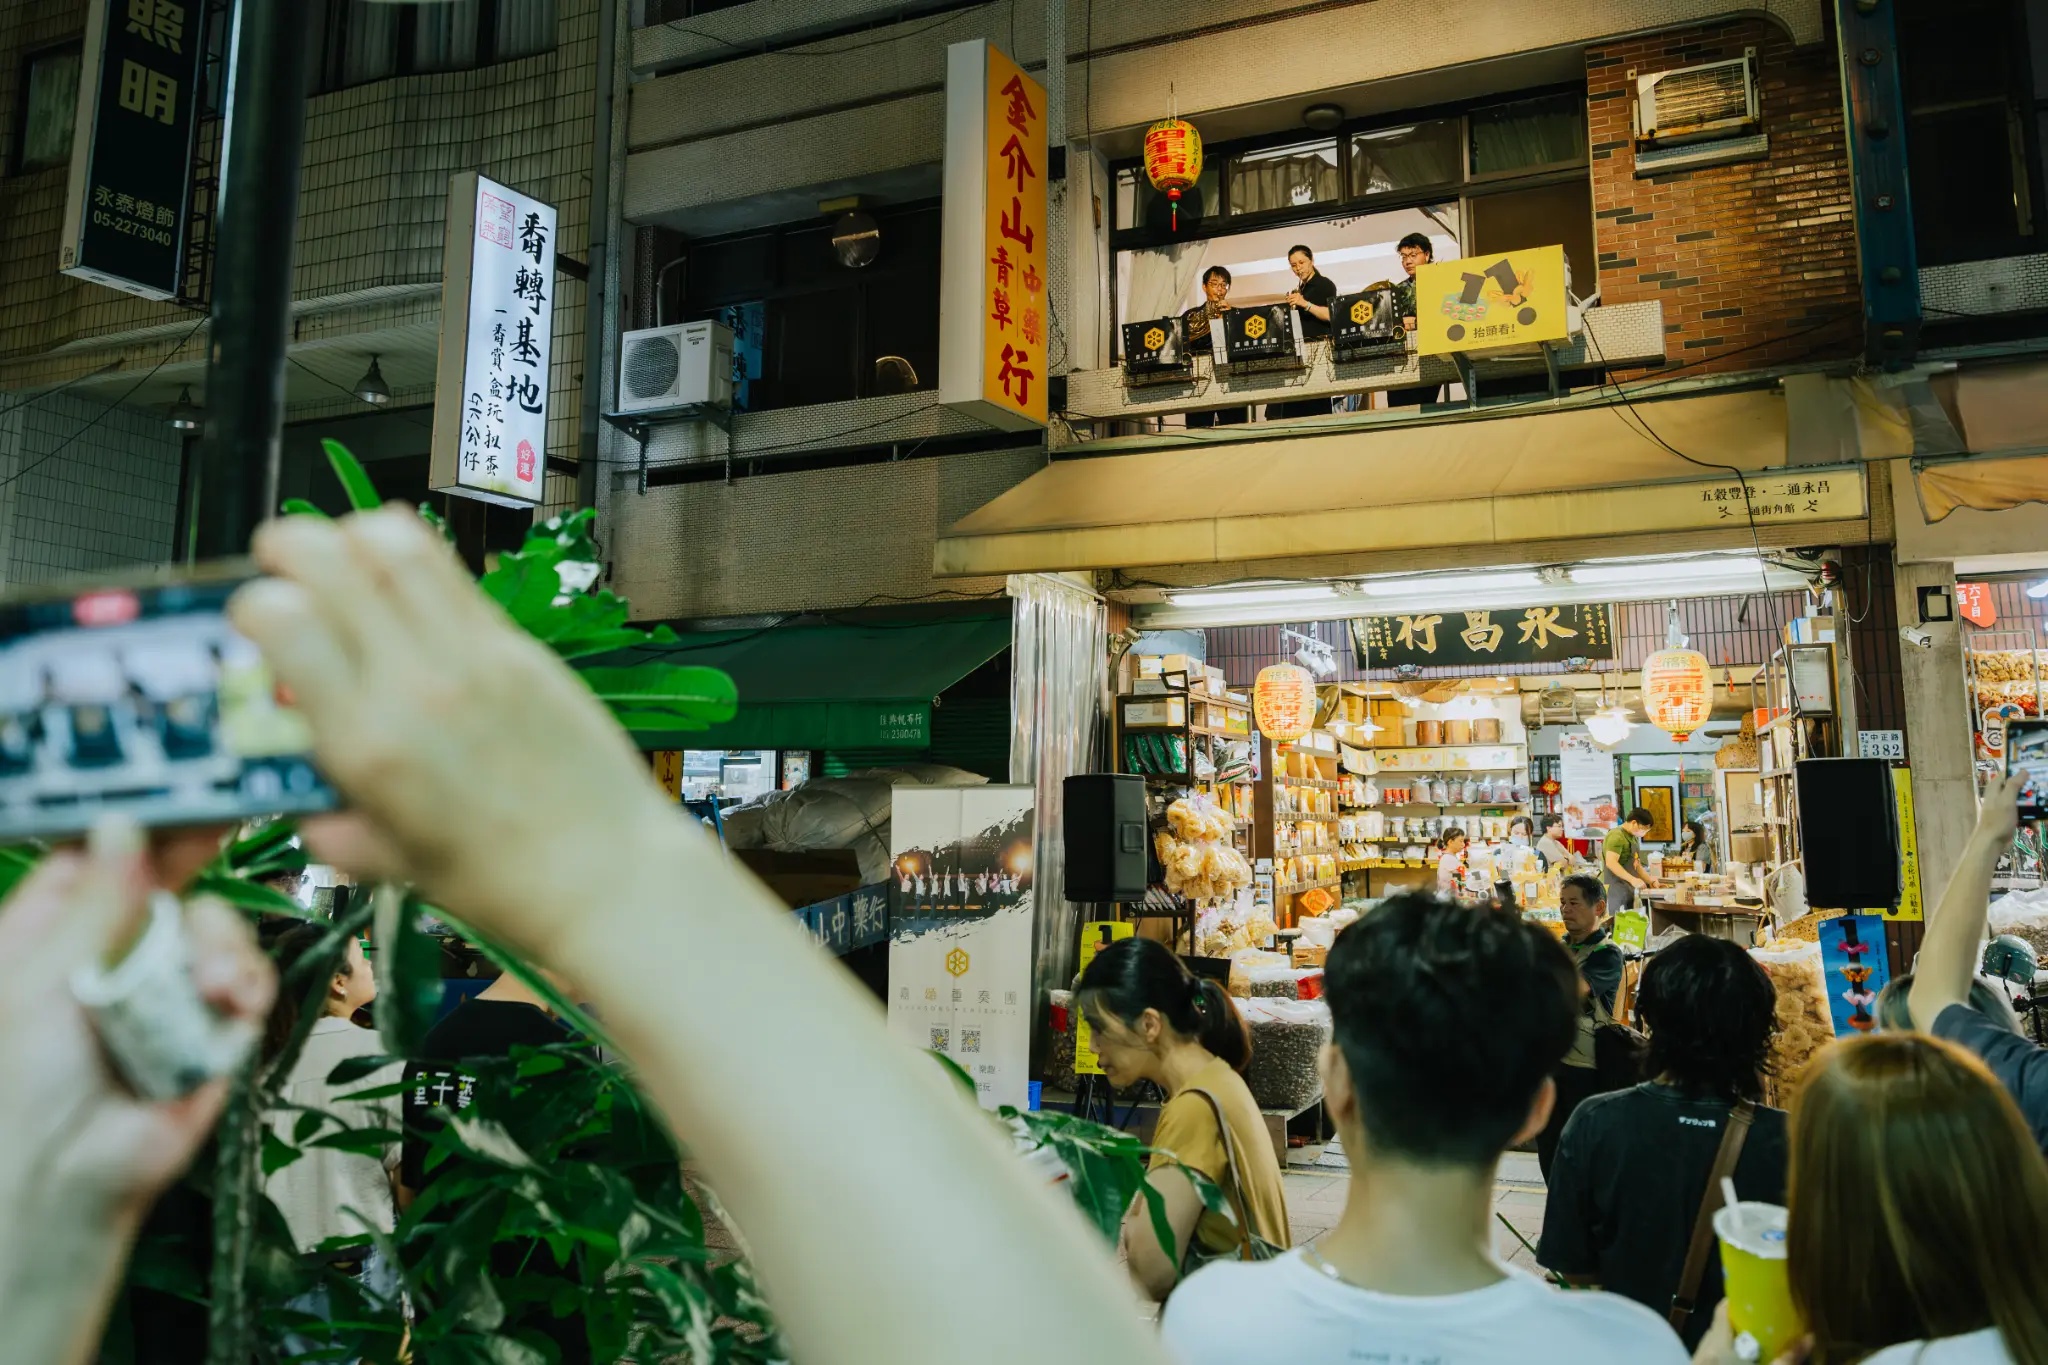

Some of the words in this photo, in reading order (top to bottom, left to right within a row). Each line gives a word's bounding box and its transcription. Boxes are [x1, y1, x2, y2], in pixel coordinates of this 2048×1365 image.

[120, 0, 185, 126] 照明
[1000, 74, 1037, 254] 金介山
[93, 208, 172, 247] 05-2273040
[94, 184, 175, 228] 永泰燈飾
[505, 211, 549, 415] 番轉基地
[990, 245, 1014, 331] 青草
[1021, 264, 1043, 347] 中藥
[997, 342, 1036, 407] 行
[1396, 604, 1579, 654] 永昌行
[1968, 584, 1981, 618] 六丁目
[1870, 732, 1899, 741] 中正路
[1872, 743, 1900, 757] 382
